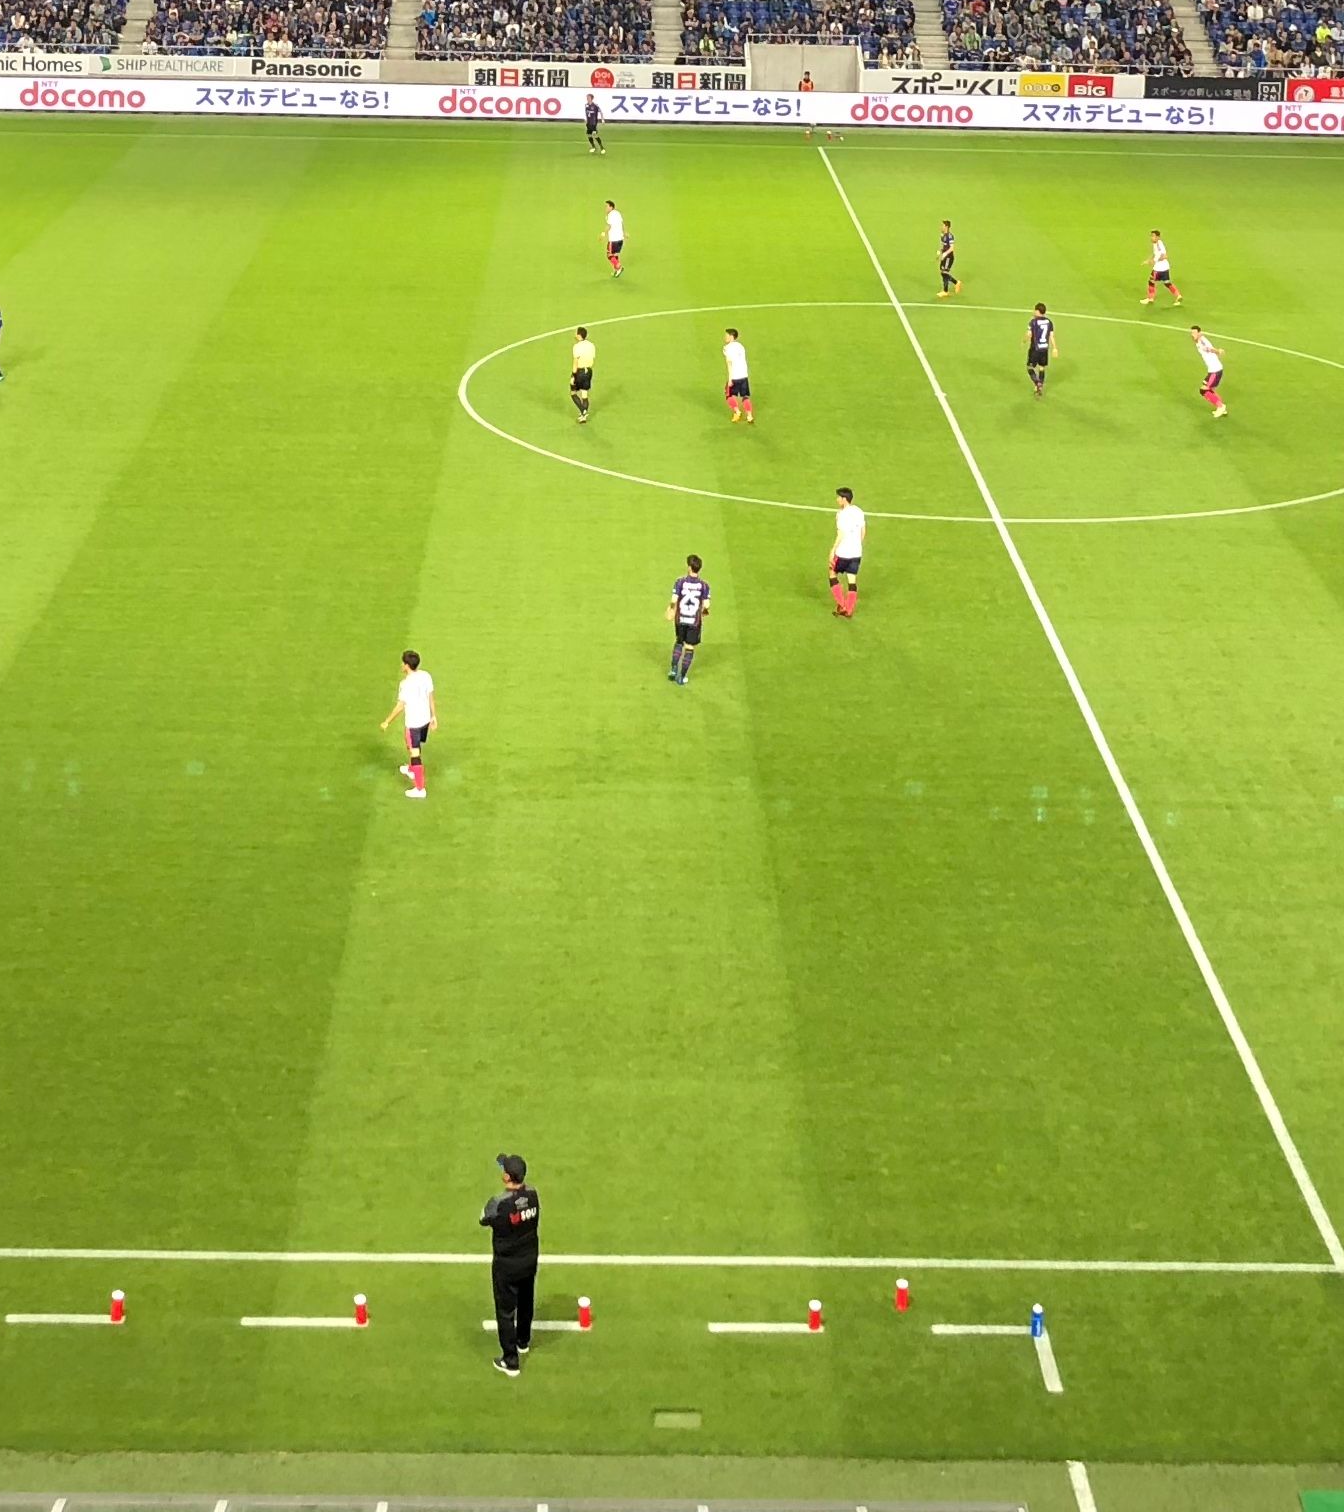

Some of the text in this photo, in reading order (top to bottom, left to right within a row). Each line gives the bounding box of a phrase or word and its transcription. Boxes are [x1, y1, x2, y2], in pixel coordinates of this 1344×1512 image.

[22, 57, 82, 73] Homes
[117, 59, 223, 72] SHIP HEALTHCARE
[251, 59, 362, 78] Panasonic
[474, 69, 569, 87] 朝日新聞
[651, 71, 745, 90] 朝日新聞
[891, 72, 1018, 96] スポーツくじ
[20, 81, 145, 108] docomo
[195, 87, 389, 109] スマホデビューなら!
[438, 88, 561, 116] docomo
[610, 95, 801, 116] スマホデビューなら!
[850, 96, 973, 123] docomo
[1021, 104, 1213, 125] スマホデビューなら!
